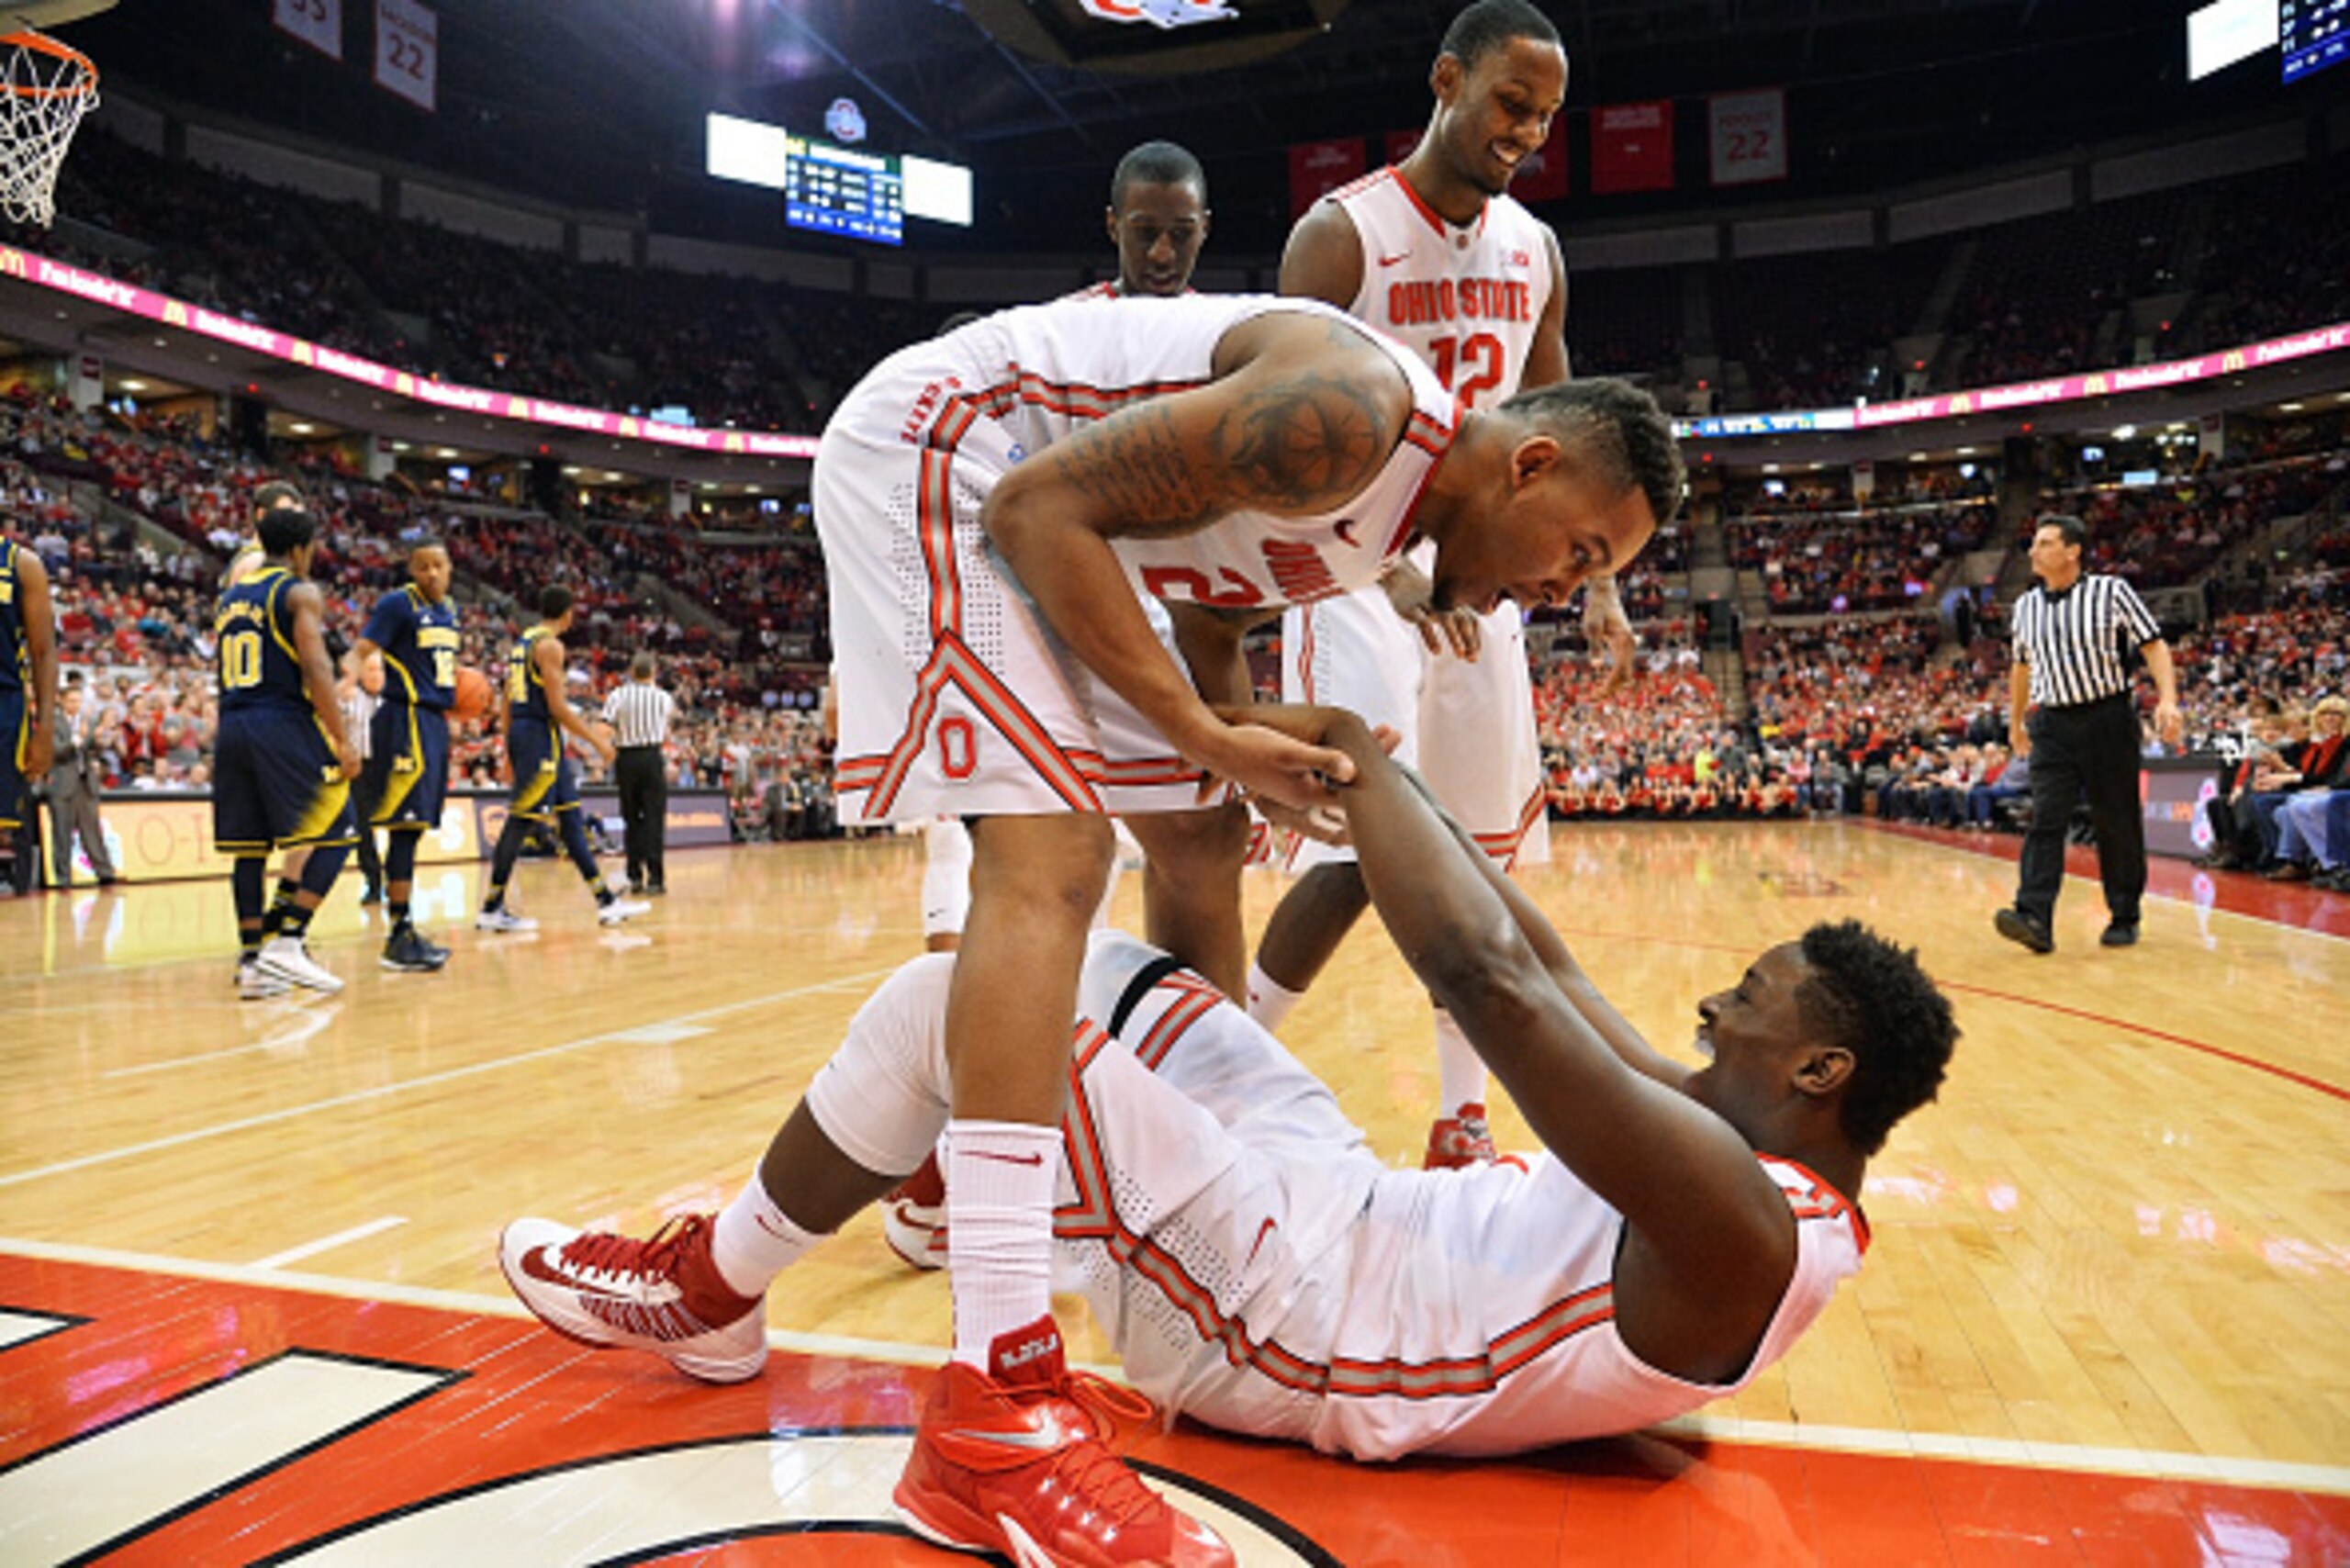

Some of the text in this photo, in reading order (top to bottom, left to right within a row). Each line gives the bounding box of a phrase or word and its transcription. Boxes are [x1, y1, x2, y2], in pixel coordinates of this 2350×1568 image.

[388, 31, 425, 81] 22
[1726, 129, 1771, 162] 22
[1388, 276, 1531, 326] OHIO STATE
[1428, 331, 1505, 409] 12
[221, 630, 263, 691] 10
[935, 714, 979, 780] O
